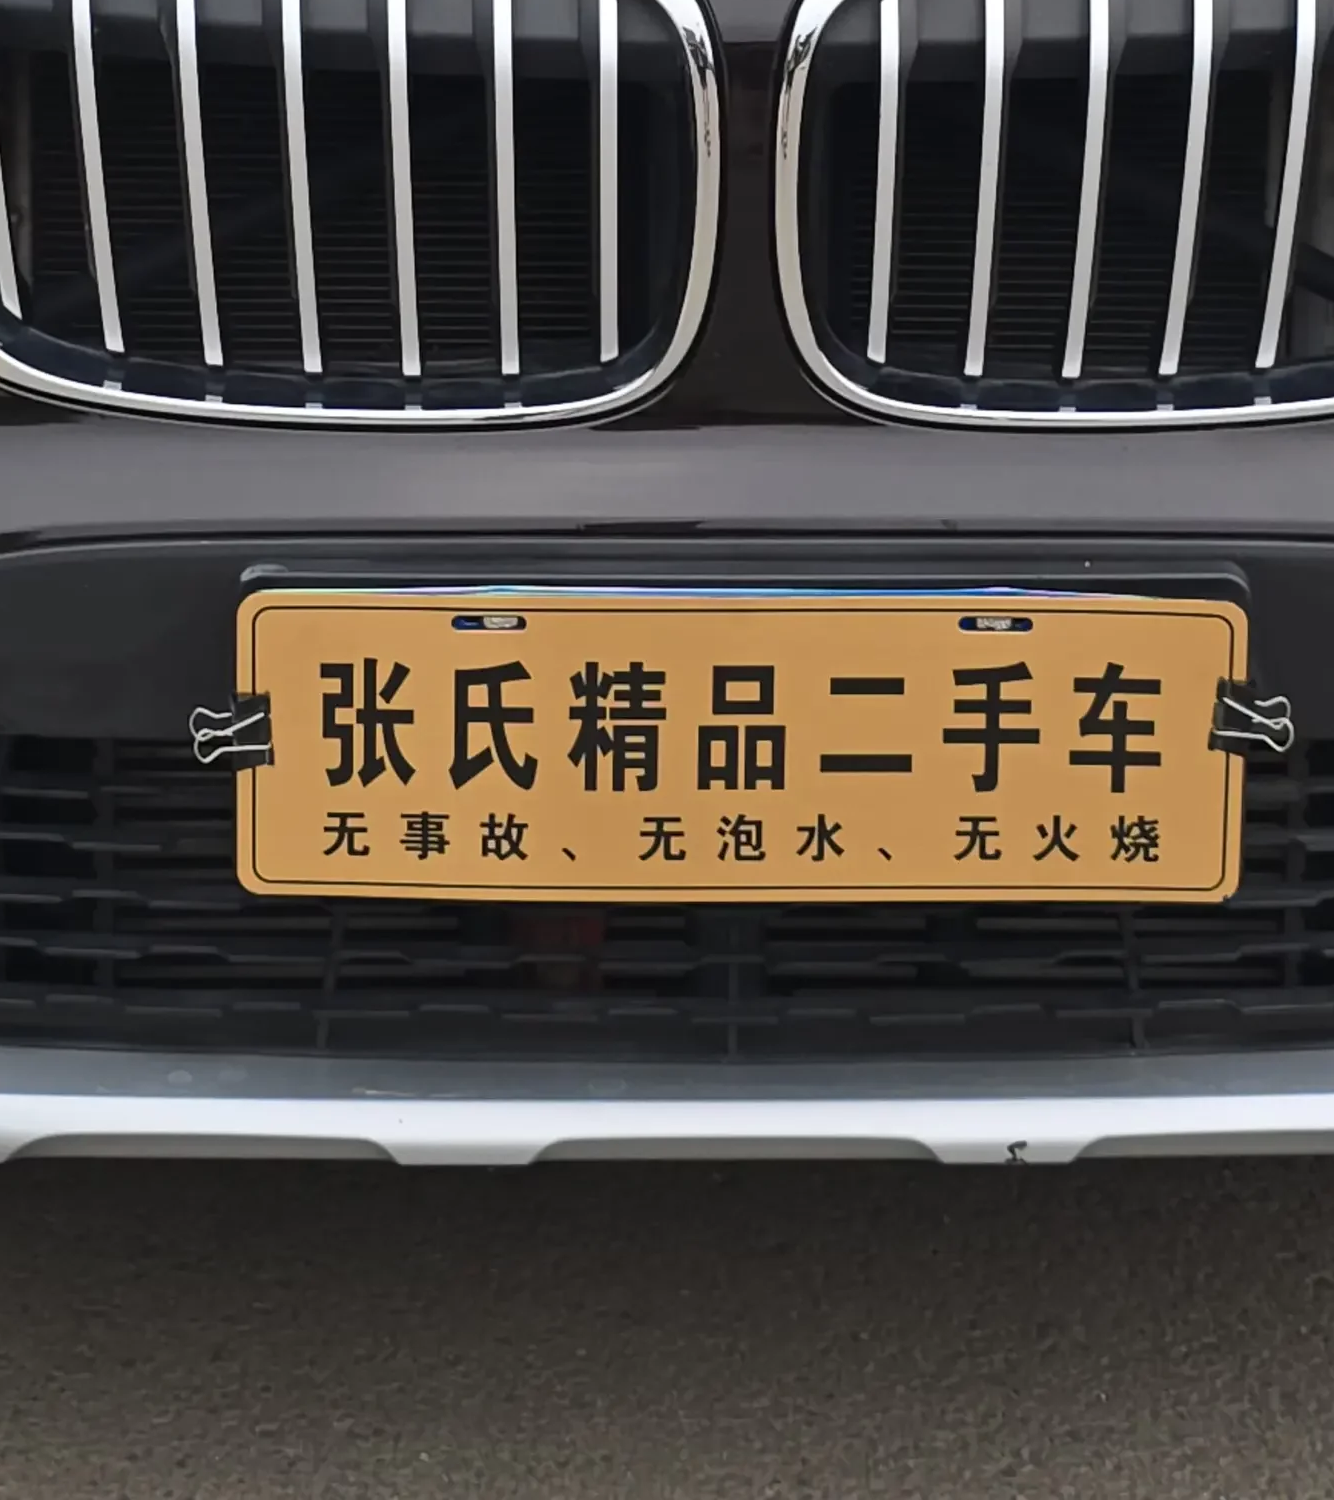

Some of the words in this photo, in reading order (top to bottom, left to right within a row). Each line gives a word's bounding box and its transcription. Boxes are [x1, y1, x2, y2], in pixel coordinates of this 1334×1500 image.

[319, 657, 1162, 793] 张氏精品二手车
